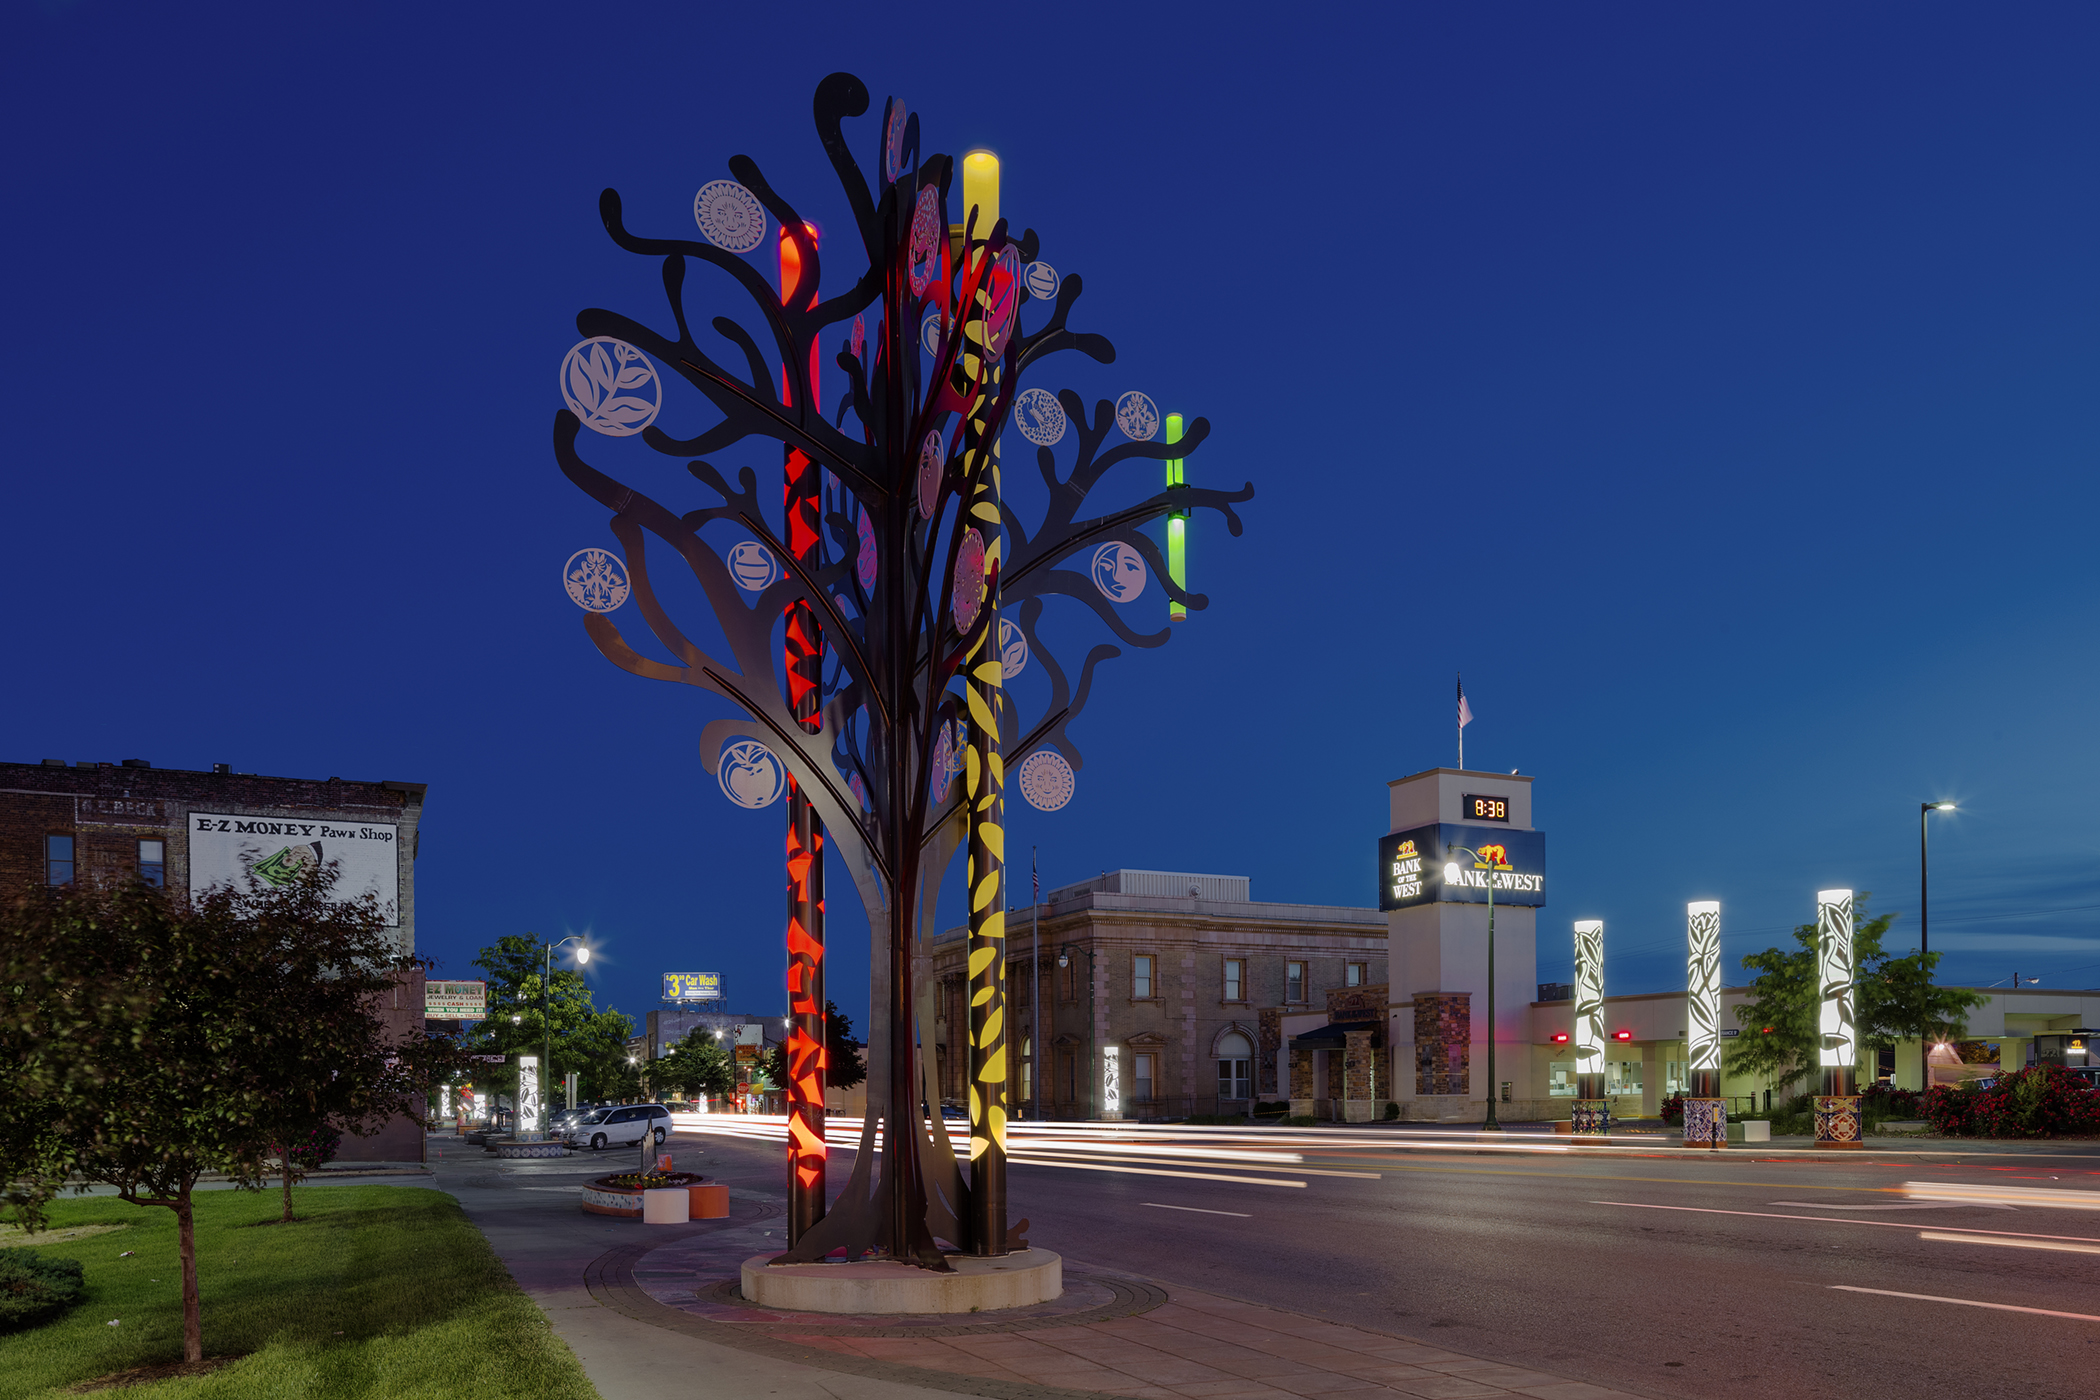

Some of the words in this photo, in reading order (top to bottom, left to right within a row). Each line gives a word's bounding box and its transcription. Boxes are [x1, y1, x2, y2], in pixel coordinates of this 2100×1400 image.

[114, 801, 156, 816] BECK
[1475, 799, 1505, 818] 8:38
[197, 818, 231, 833] E-Z
[235, 820, 315, 836] MONEY
[321, 826, 356, 838] Pawn
[360, 828, 393, 843] Shop
[1393, 857, 1422, 876] BANK
[1398, 876, 1405, 884] OF
[1406, 873, 1417, 882] THE
[1444, 867, 1488, 887] ANK
[1500, 872, 1543, 891] WEST
[1393, 881, 1422, 898] WEST
[686, 974, 698, 986] Car
[698, 974, 718, 986] Wash
[427, 984, 441, 994] EZ
[444, 985, 483, 995] MONEY
[1335, 1011, 1350, 1019] BANK
[1357, 1009, 1374, 1017] WEST
